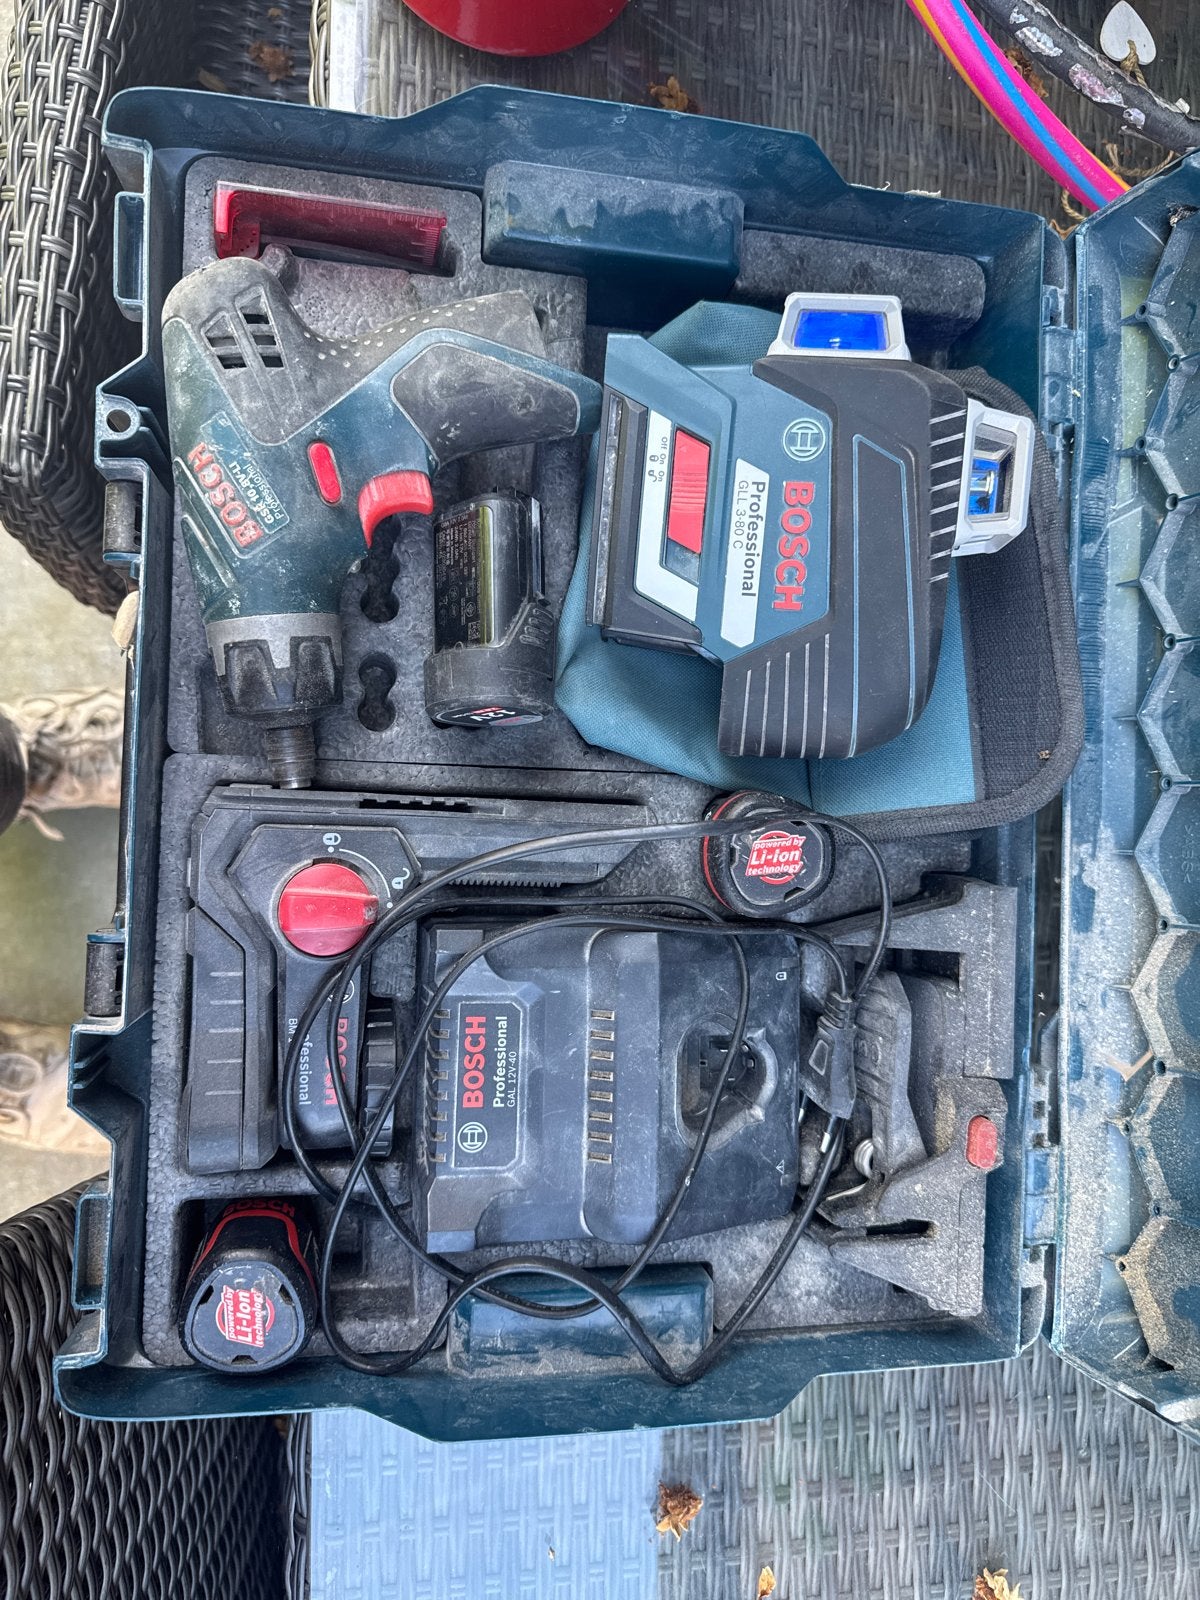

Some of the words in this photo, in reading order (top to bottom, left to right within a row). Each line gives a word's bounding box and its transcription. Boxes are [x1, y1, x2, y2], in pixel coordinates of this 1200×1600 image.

[660, 436, 668, 450] Off
[659, 453, 667, 465] On
[657, 470, 665, 482] On
[187, 442, 263, 548] BOSCH
[242, 463, 285, 520] Professional
[737, 480, 749, 505] GLL
[734, 509, 747, 536] 3-80
[732, 540, 744, 550] C
[741, 481, 766, 597] Professional
[772, 481, 815, 611] BOSCH
[755, 839, 791, 850] powered
[793, 837, 804, 847] by
[748, 864, 799, 875] technology
[463, 1016, 487, 1108] BOSCH
[493, 1016, 508, 1108] Professional
[507, 1051, 517, 1084] 12V-40
[507, 1087, 516, 1108] GAL
[224, 1286, 235, 1299] by
[227, 1299, 237, 1339] powered
[235, 1291, 253, 1343] Li-Ion
